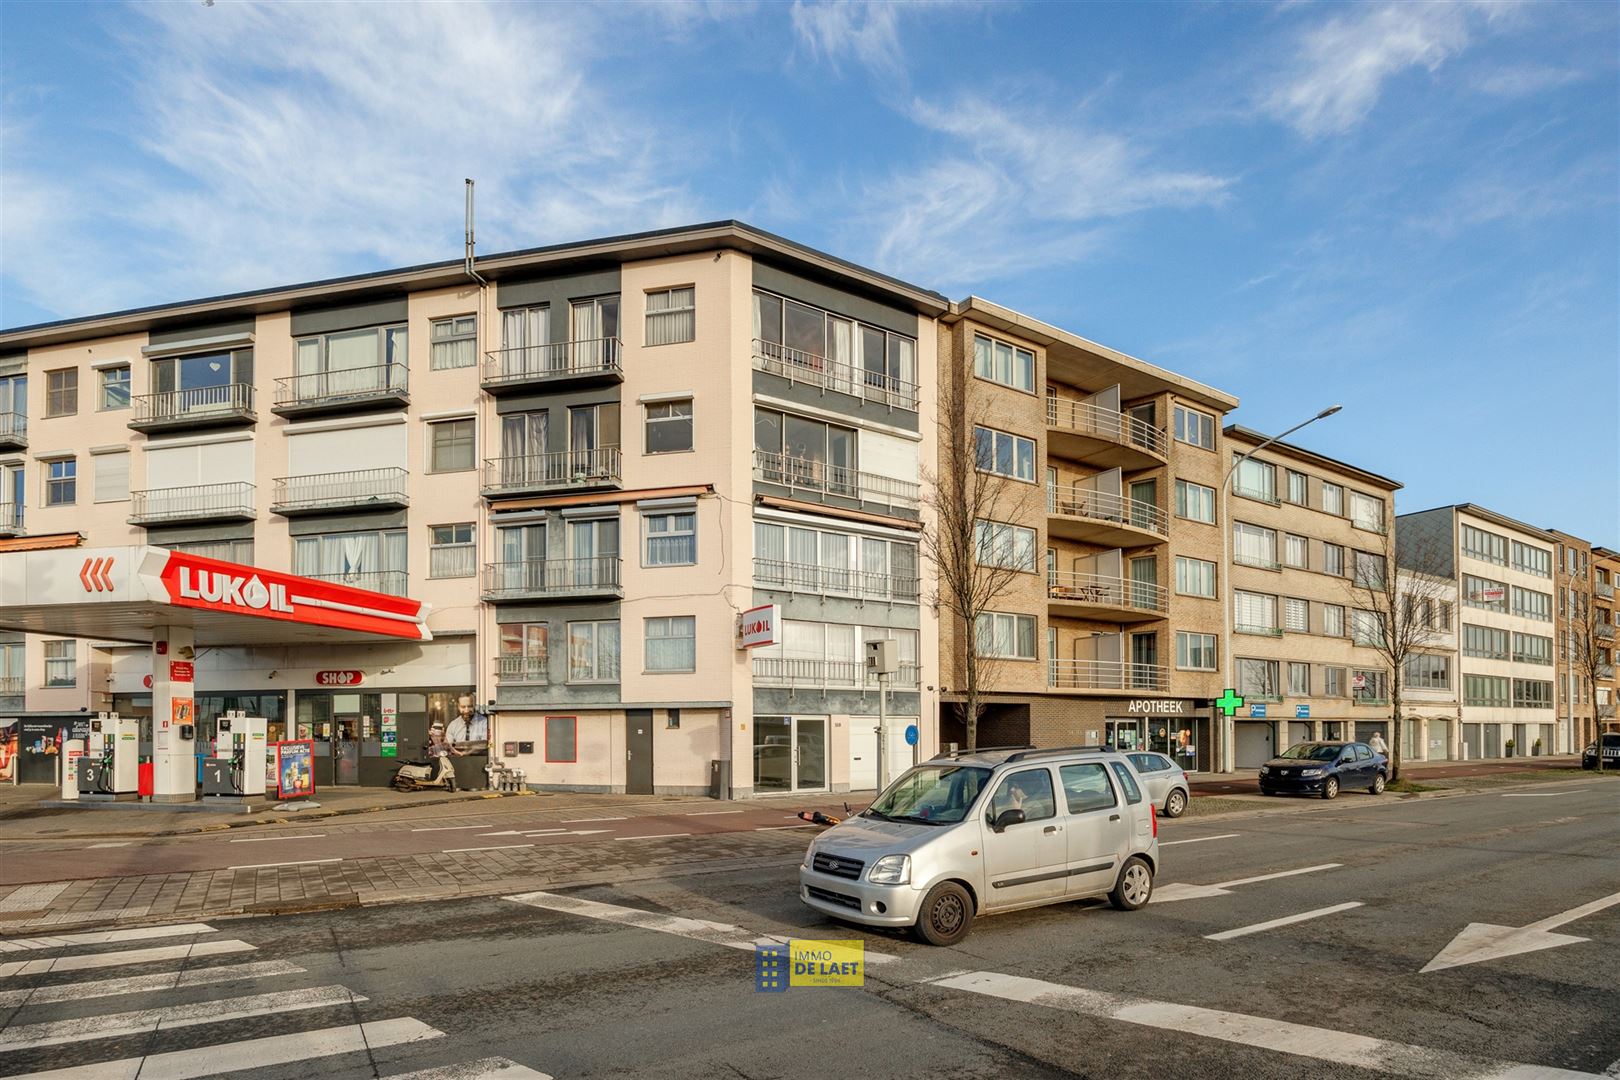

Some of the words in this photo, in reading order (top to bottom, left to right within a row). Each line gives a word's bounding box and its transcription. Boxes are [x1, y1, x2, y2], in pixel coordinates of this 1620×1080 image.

[179, 566, 294, 613] LUKOIL
[744, 620, 770, 636] LUKOIL
[322, 671, 354, 684] SHOP
[1128, 700, 1183, 713] APOTHEEK
[86, 769, 94, 781] 3
[214, 769, 221, 783] 1
